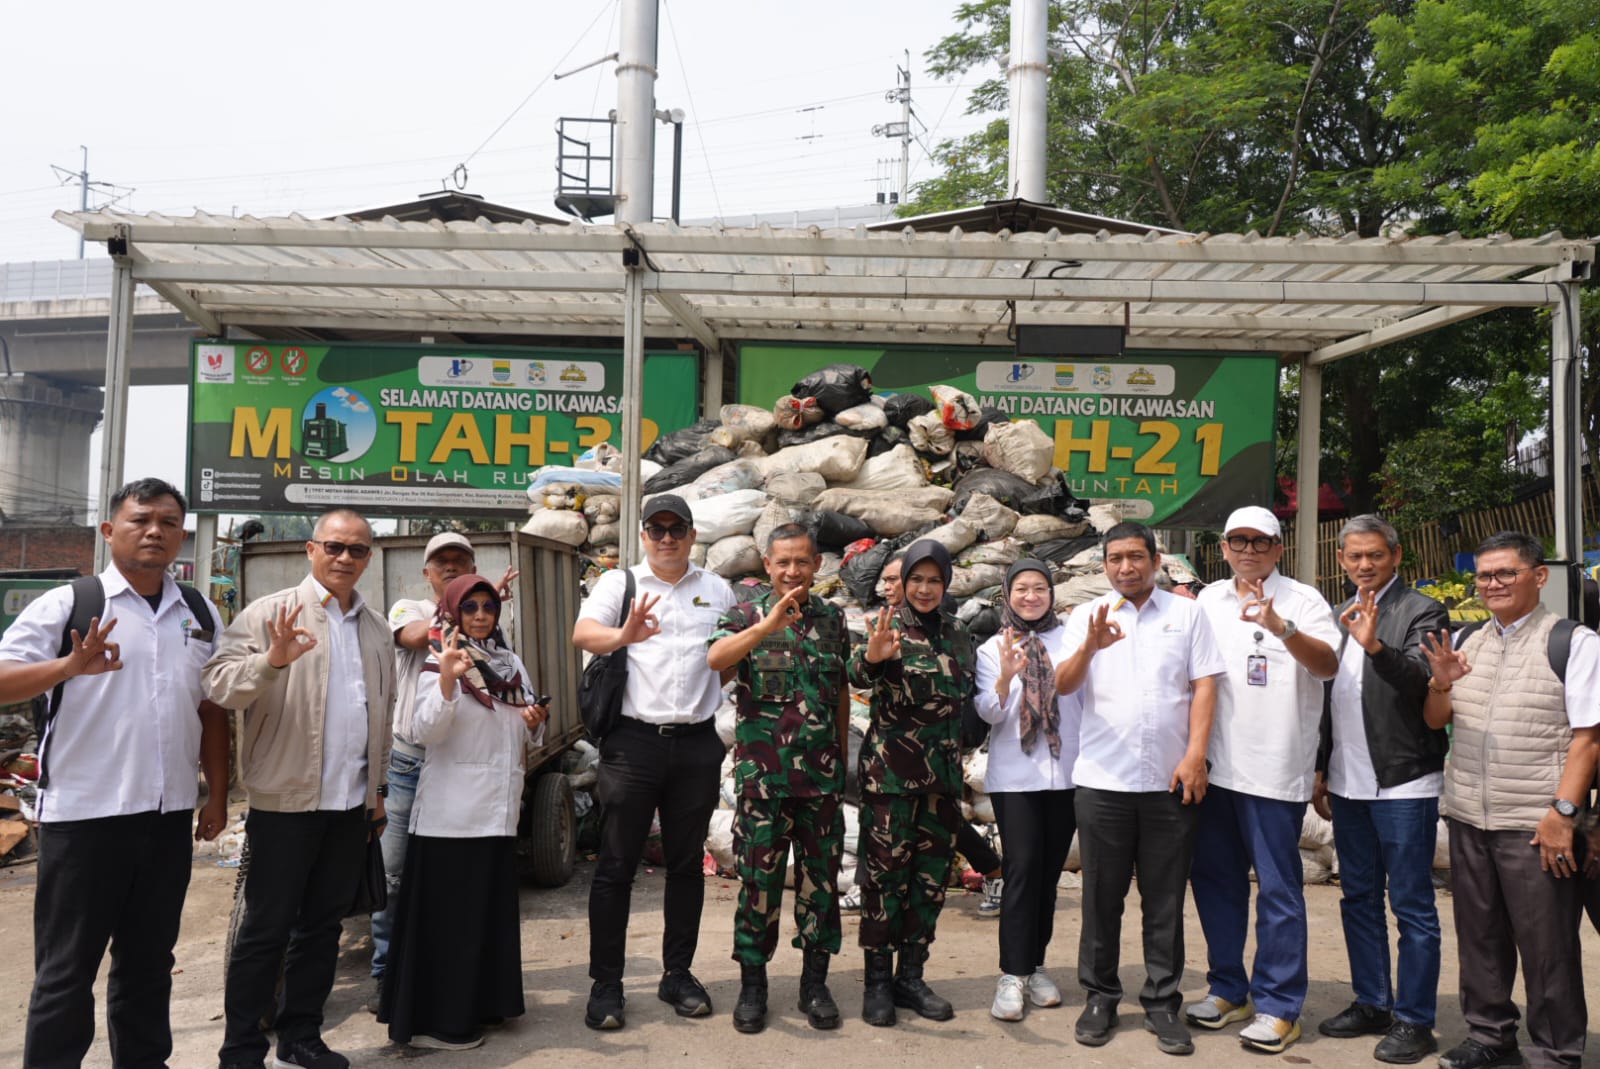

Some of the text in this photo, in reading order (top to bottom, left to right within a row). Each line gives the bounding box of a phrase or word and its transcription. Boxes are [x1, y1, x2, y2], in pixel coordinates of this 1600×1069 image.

[380, 388, 459, 409] SELAMAT
[462, 391, 532, 411] DATANG
[536, 394, 554, 412] DI
[1020, 397, 1096, 416] DATANG
[1100, 398, 1117, 417] DI
[1121, 399, 1215, 418] KAWASAN
[273, 463, 365, 481] MESIN
[391, 466, 468, 484] OLAH
[1072, 478, 1178, 495] UNTAH
